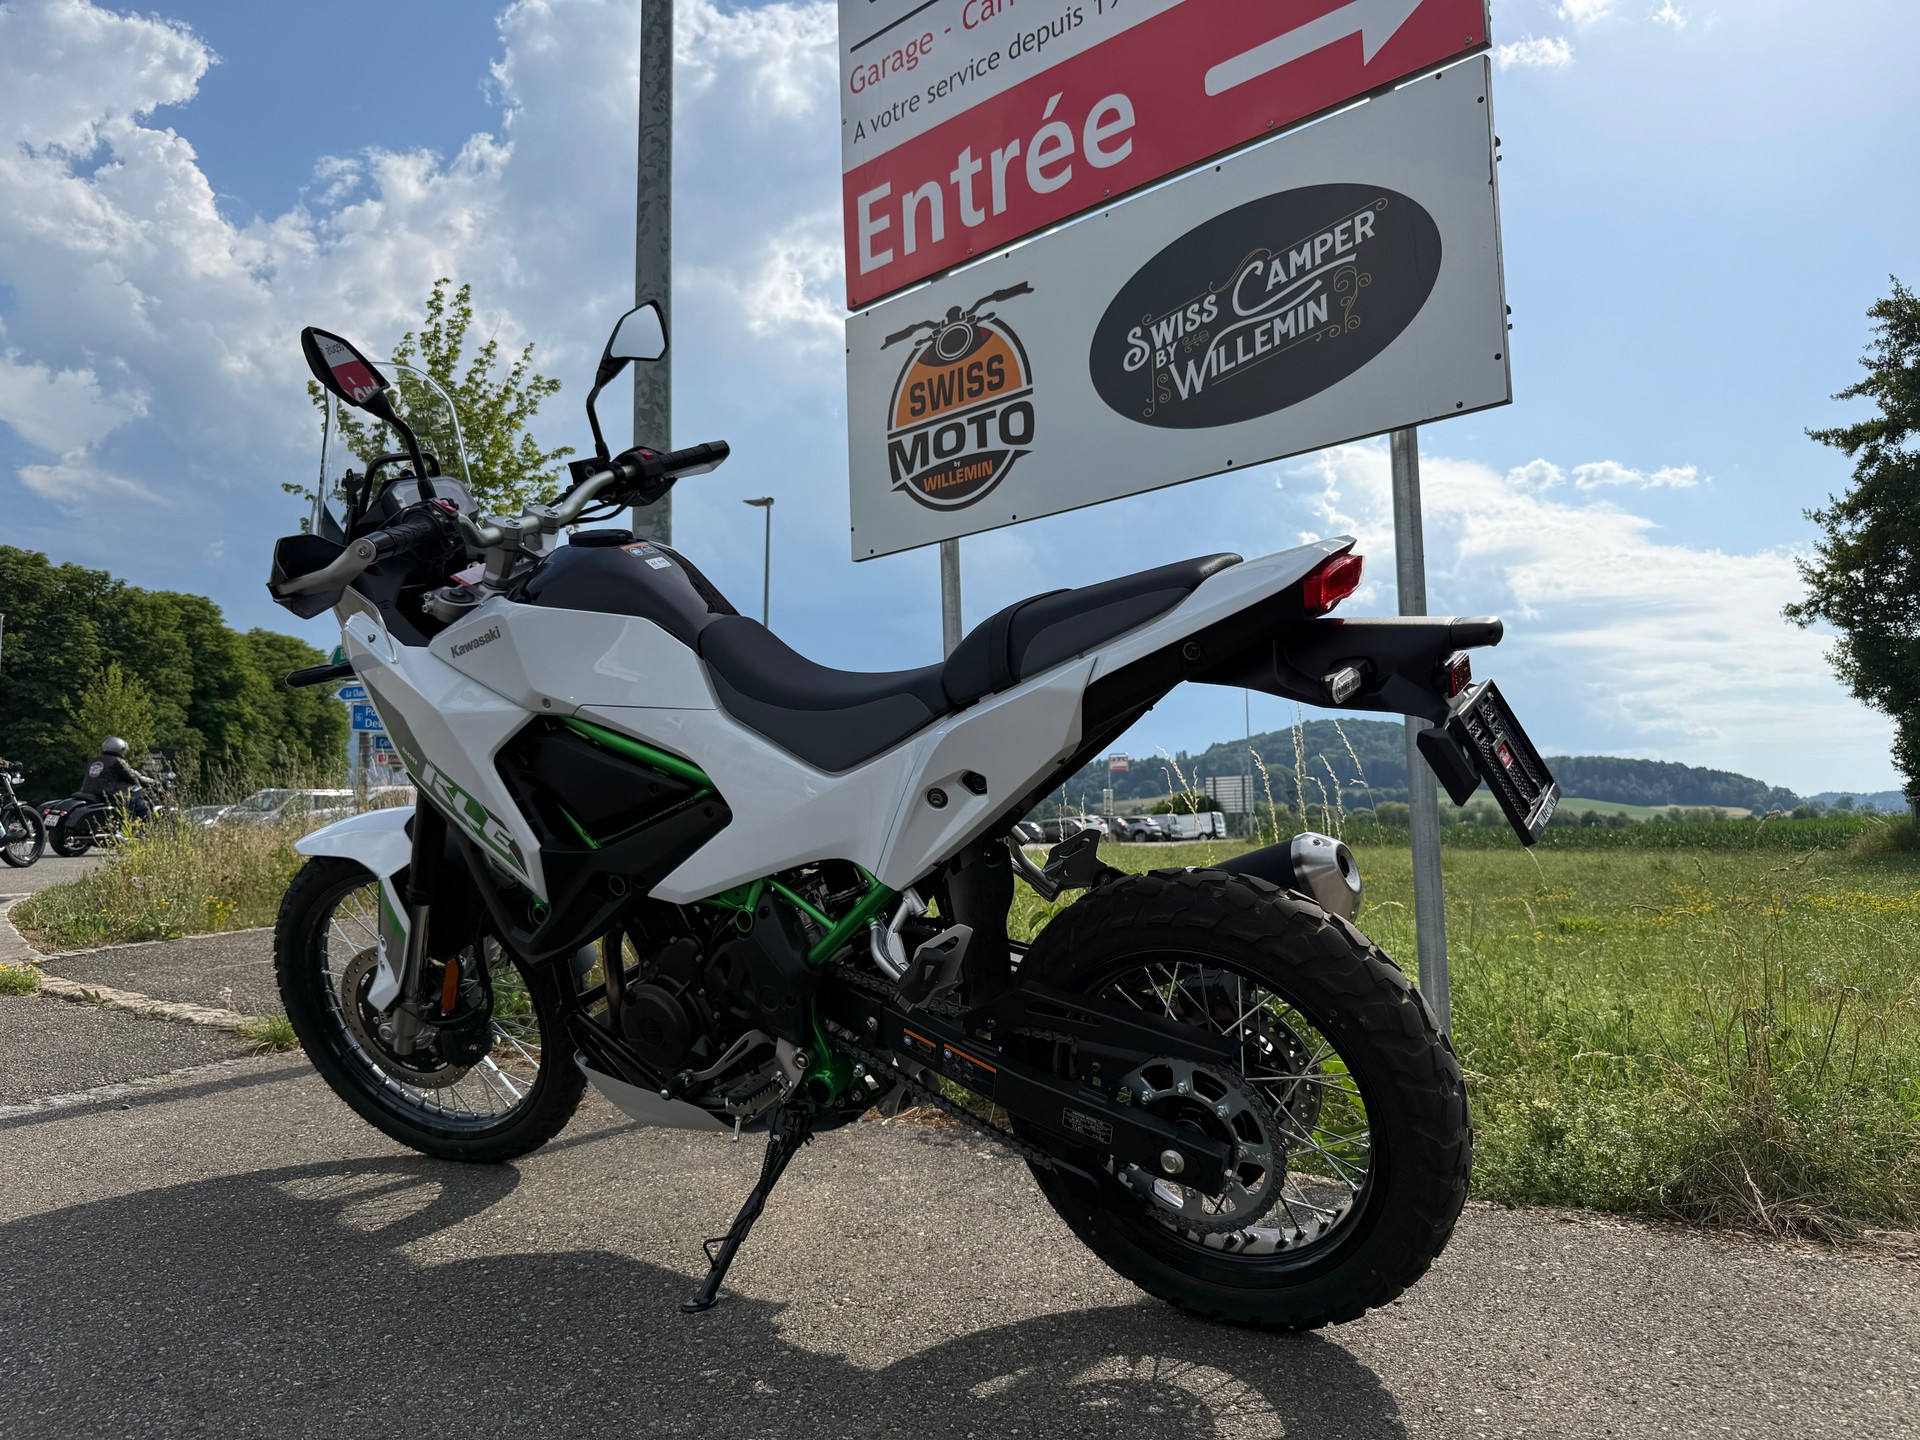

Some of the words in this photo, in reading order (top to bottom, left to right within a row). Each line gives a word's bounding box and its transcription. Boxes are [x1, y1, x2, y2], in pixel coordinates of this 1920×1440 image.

[849, 31, 934, 95] Garage
[853, 120, 866, 144] A
[870, 94, 920, 133] votre
[927, 51, 1000, 104] service
[1008, 5, 1084, 60] depuis
[859, 92, 1136, 276] Entrée
[1123, 294, 1218, 372] SWISS
[1232, 210, 1375, 317] CAMPER
[1155, 342, 1178, 369] BY
[1168, 282, 1329, 401] WILLEMIN
[909, 353, 1005, 418] SWISS
[887, 400, 1035, 485] MOTO
[953, 460, 961, 468] by
[923, 459, 993, 493] WILLEMIN
[450, 625, 502, 659] Kawasaki
